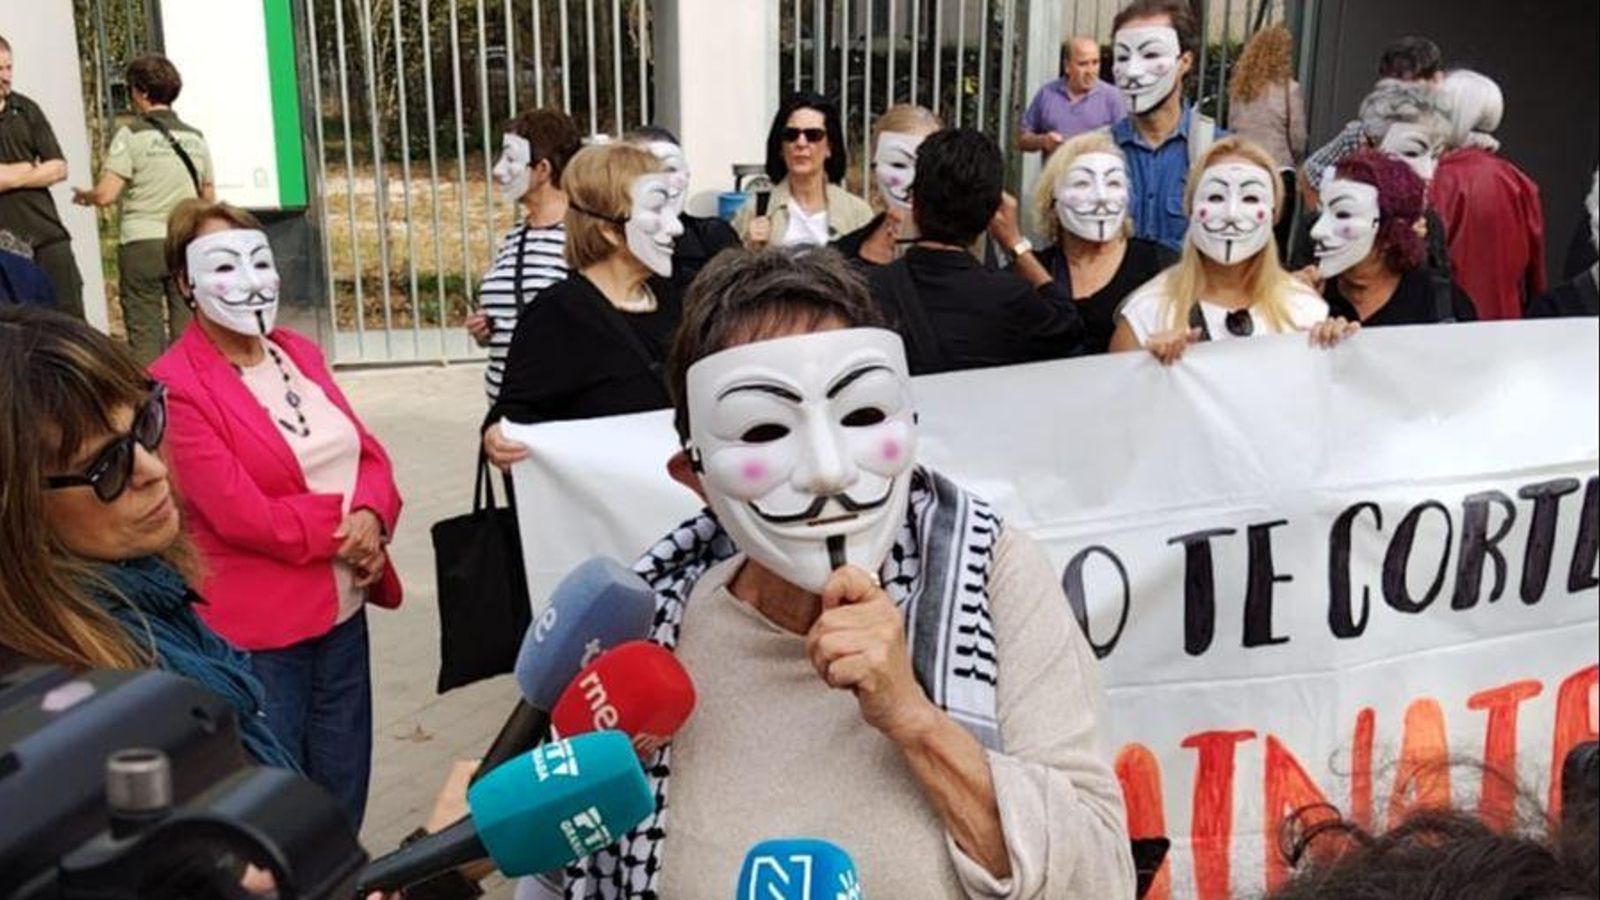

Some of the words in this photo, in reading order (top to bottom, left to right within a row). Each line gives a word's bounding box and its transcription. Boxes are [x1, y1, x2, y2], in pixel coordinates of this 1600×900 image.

[1062, 546, 1130, 660] O
[1168, 519, 1293, 657] TE
[579, 671, 619, 732] rne
